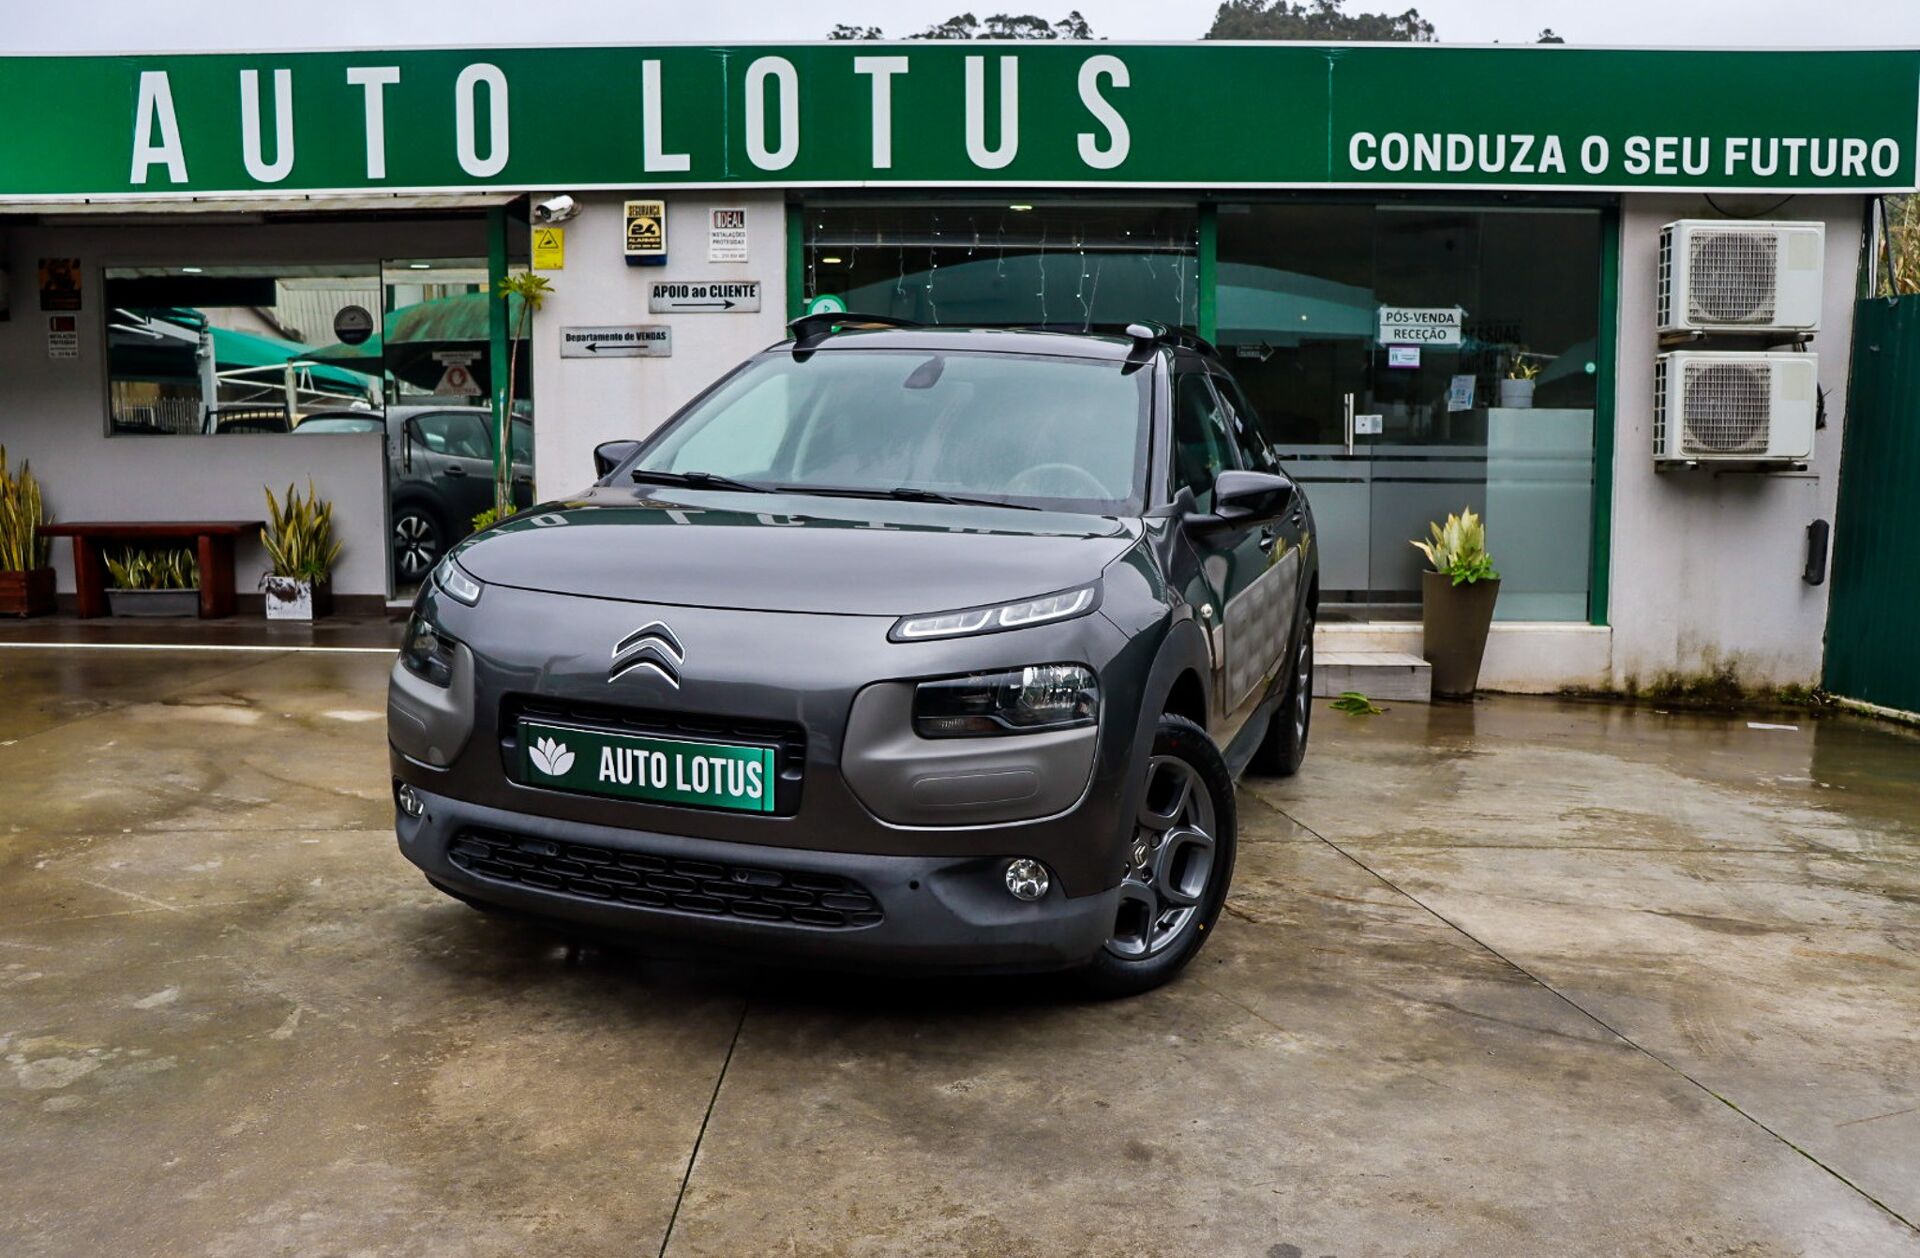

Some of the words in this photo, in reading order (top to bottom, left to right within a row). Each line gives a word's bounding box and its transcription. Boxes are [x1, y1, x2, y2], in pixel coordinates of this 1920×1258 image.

[130, 62, 510, 184] AUTO
[642, 54, 1131, 172] LOTUS
[1348, 131, 1567, 174] CONDUZA
[1580, 135, 1609, 173] O
[1623, 136, 1711, 176] SEU
[1725, 137, 1900, 178] FUTURO
[653, 285, 689, 299] APOIO
[691, 286, 707, 298] ao
[709, 284, 756, 298] CLIENTE
[1386, 310, 1455, 323] PÓS-VENDA
[565, 332, 623, 343] Departamento
[624, 332, 635, 341] de
[635, 331, 667, 341] VENDAS
[1394, 327, 1447, 342] RECEÇÃO
[599, 746, 668, 789] AUTO
[675, 753, 763, 798] LOTUS
